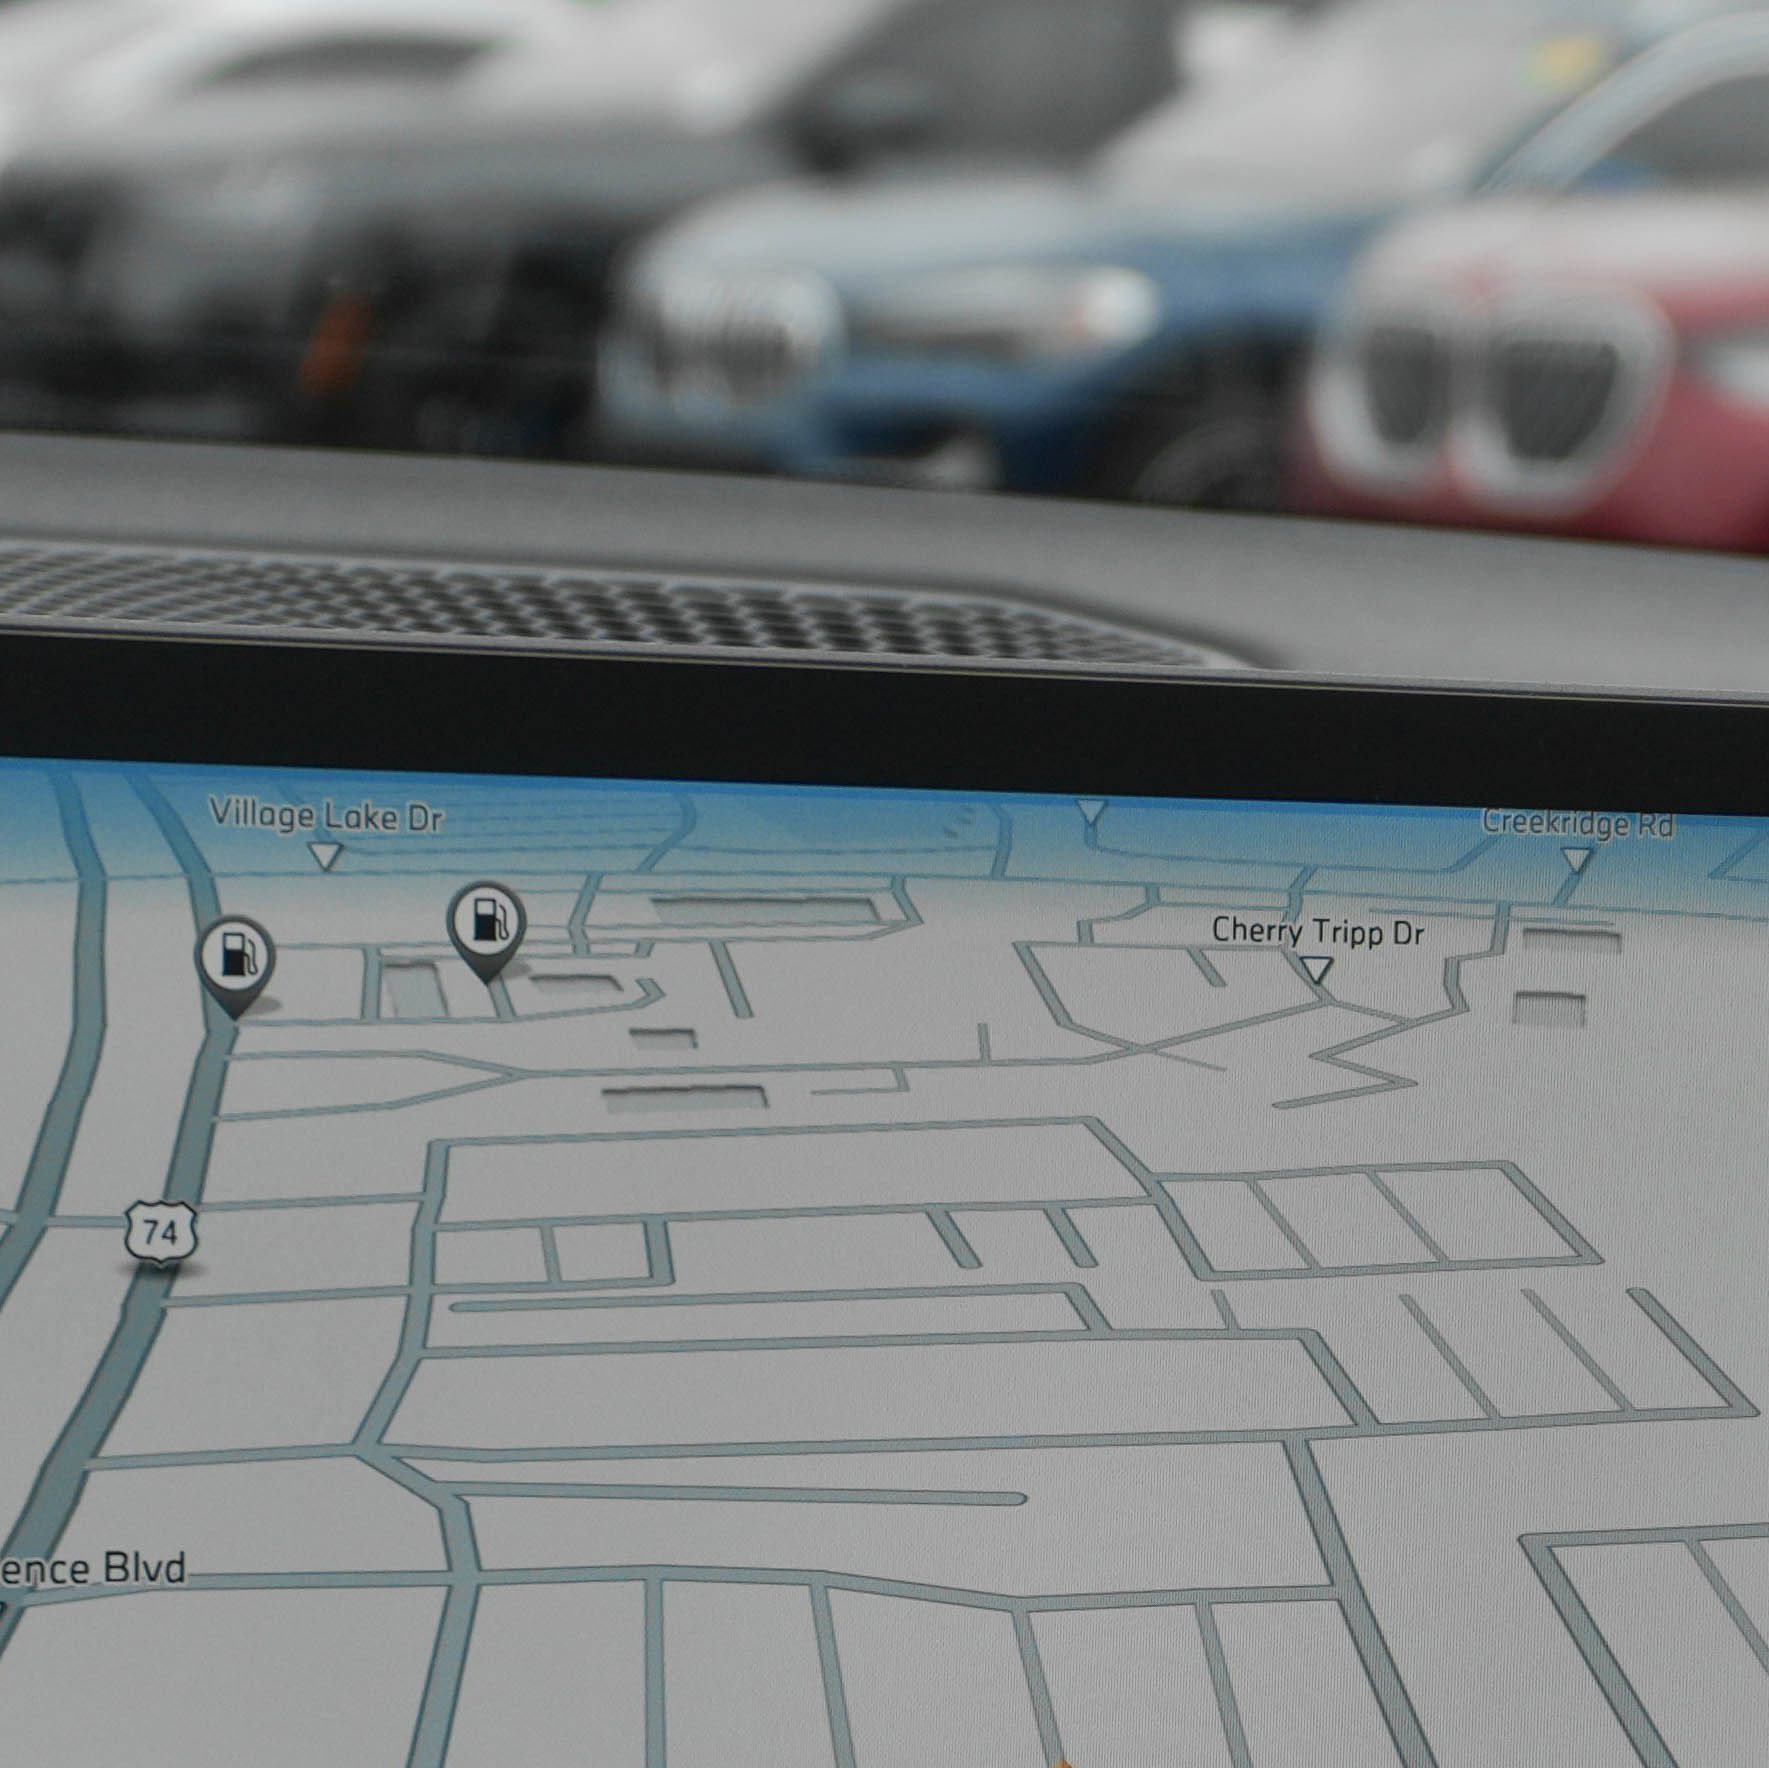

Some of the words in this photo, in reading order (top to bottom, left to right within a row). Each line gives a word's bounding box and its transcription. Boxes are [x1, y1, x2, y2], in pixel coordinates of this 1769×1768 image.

[209, 797, 314, 834] Village
[325, 800, 398, 831] Lake
[408, 803, 443, 832] Dr
[1483, 808, 1630, 843] Creekridge
[1638, 812, 1674, 838] Rd
[1212, 914, 1304, 949] Cherry
[1312, 918, 1384, 950] Tripp
[1394, 920, 1425, 946] Dr
[143, 1218, 178, 1246] 74
[104, 1550, 186, 1584] Blvd
